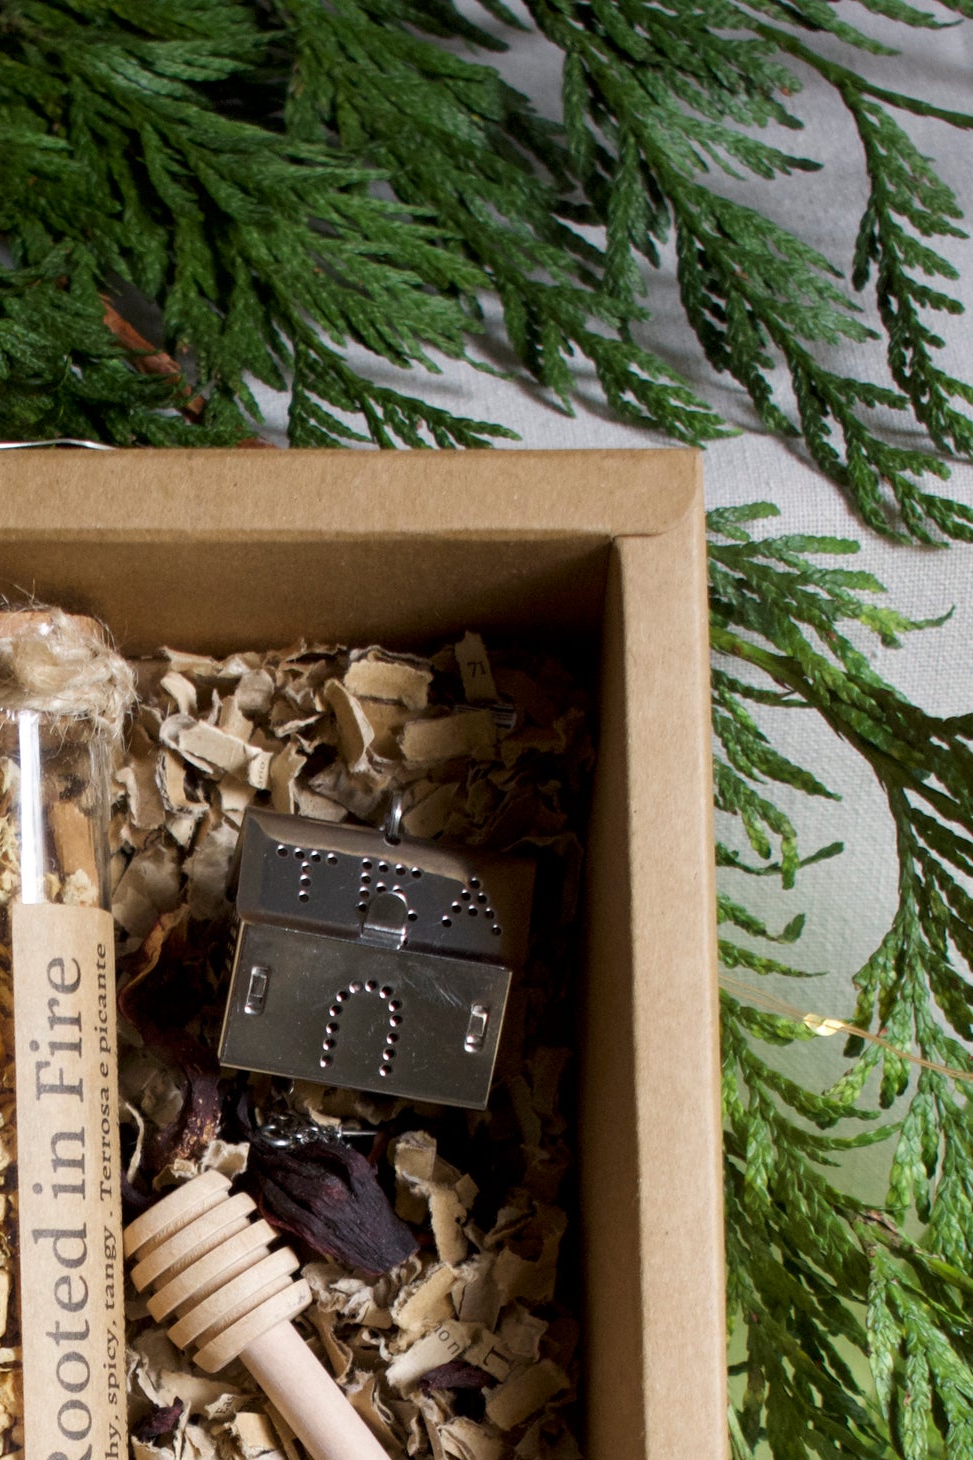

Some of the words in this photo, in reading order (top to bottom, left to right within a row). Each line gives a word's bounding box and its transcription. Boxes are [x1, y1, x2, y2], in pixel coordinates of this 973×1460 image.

[29, 957, 85, 1102] Fire
[95, 943, 112, 1055] picante
[100, 1062, 109, 1078] e
[31, 1127, 86, 1200] in
[98, 1086, 113, 1202] Terrosa
[103, 1225, 117, 1310] tangy
[103, 1320, 120, 1405] spicy,
